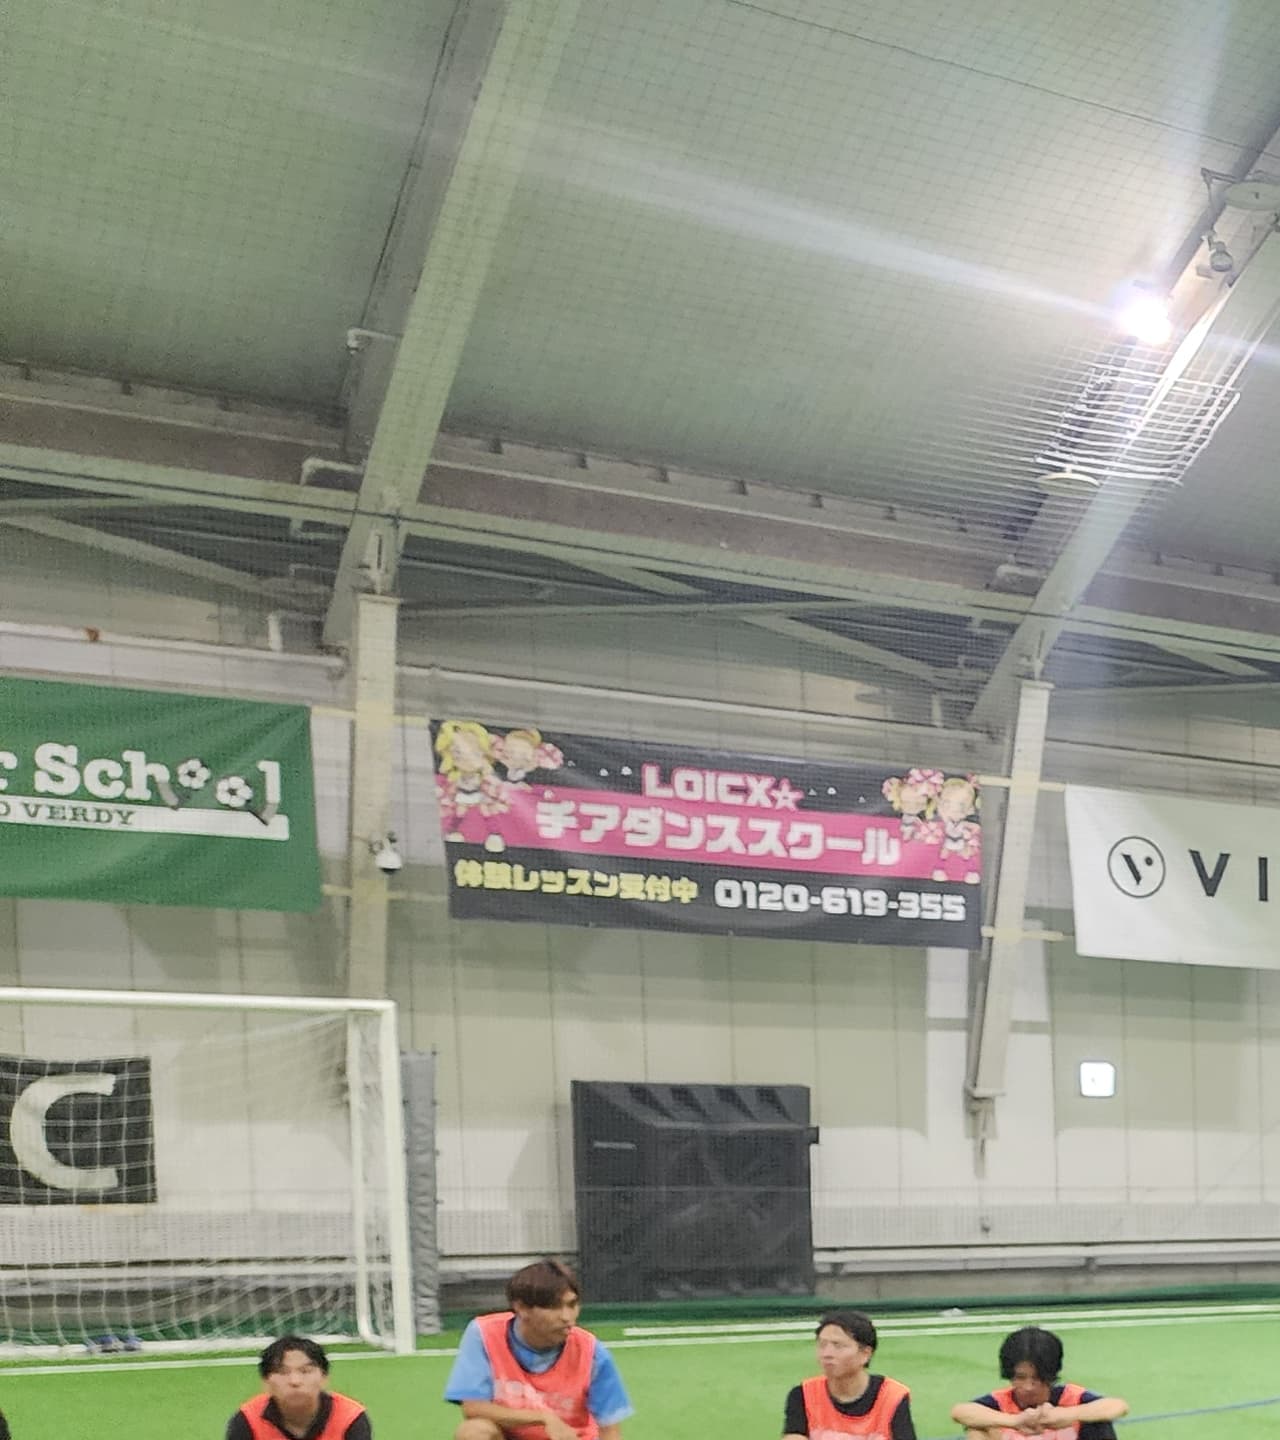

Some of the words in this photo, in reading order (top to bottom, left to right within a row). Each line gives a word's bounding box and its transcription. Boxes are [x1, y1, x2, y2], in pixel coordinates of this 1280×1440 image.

[23, 803, 136, 825] VERDY
[535, 802, 901, 866] チアダンススクール
[714, 877, 967, 923] 0120-619-355
[10, 1072, 118, 1190] C
